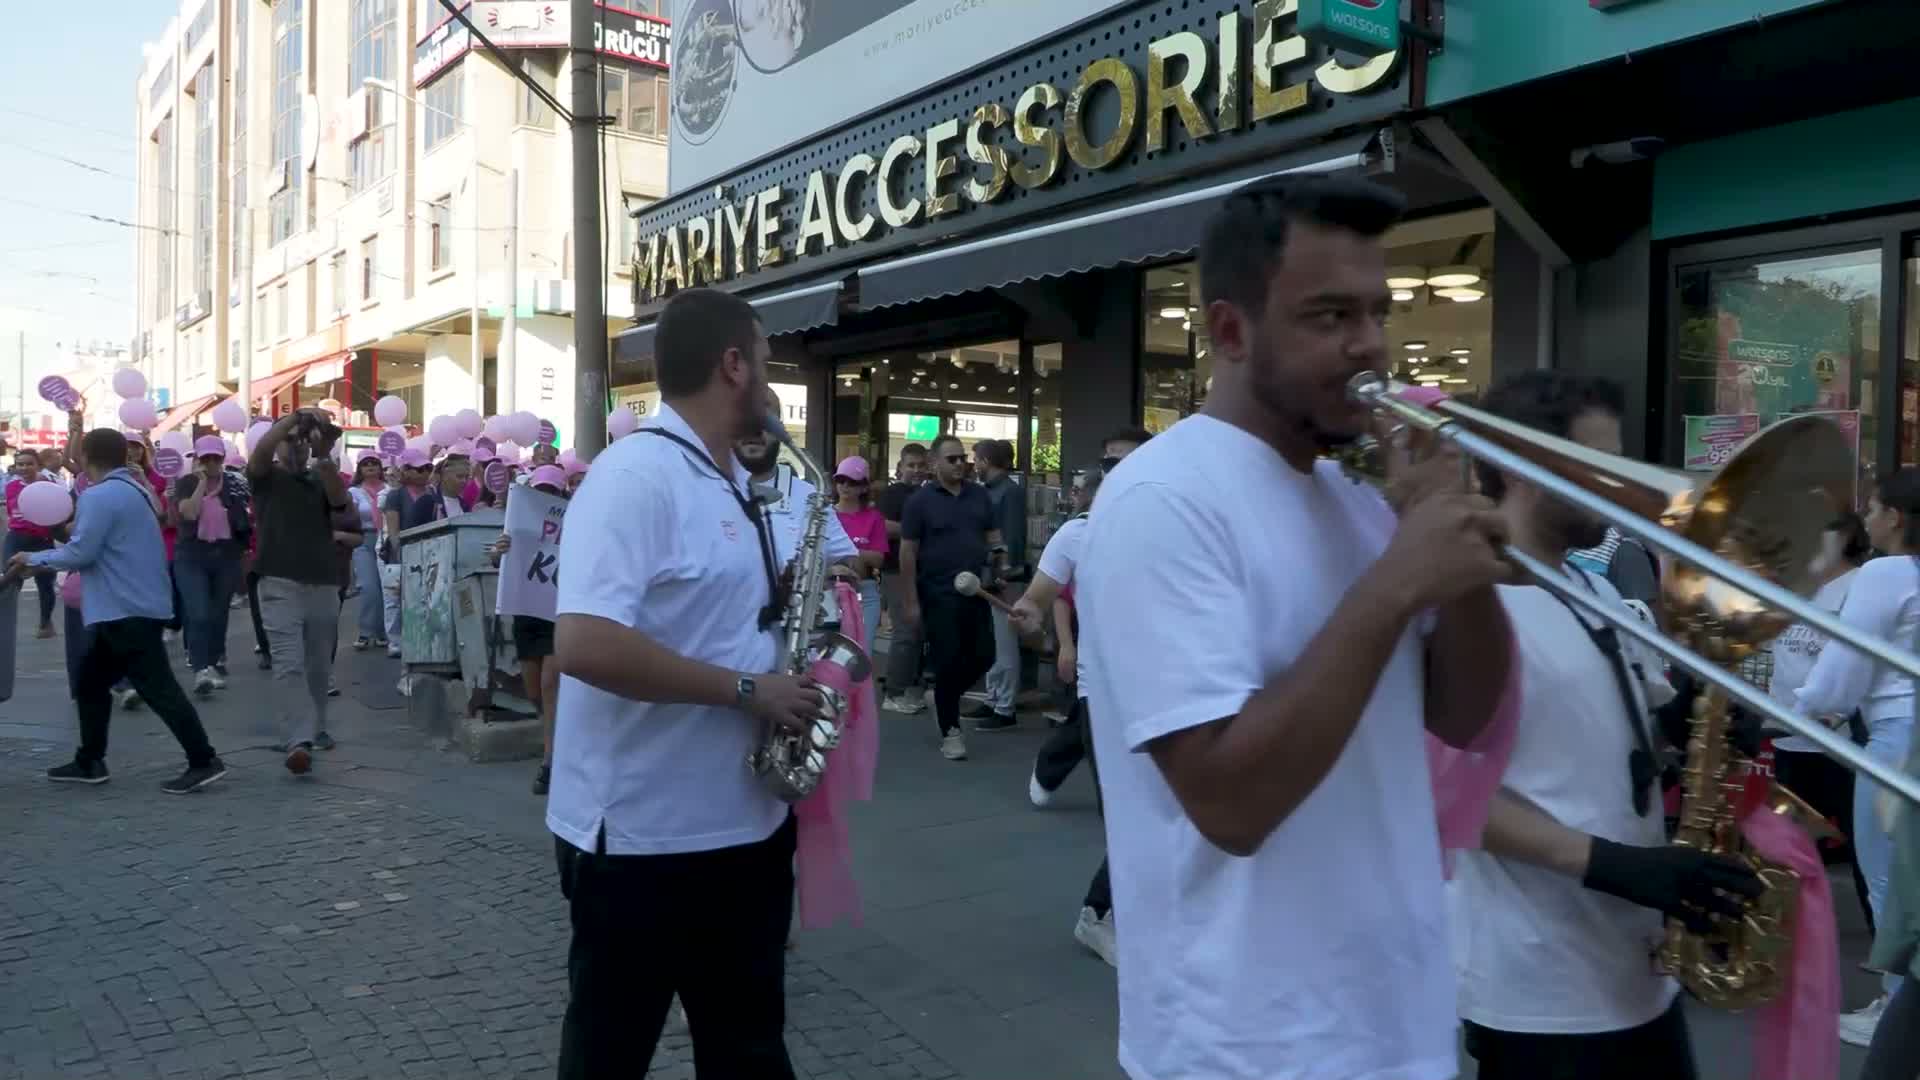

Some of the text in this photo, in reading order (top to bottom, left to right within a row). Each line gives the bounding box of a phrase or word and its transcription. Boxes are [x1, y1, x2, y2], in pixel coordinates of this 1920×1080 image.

[1331, 10, 1391, 39] watsons
[632, 184, 783, 303] MARİYE
[626, 400, 646, 416] TEB
